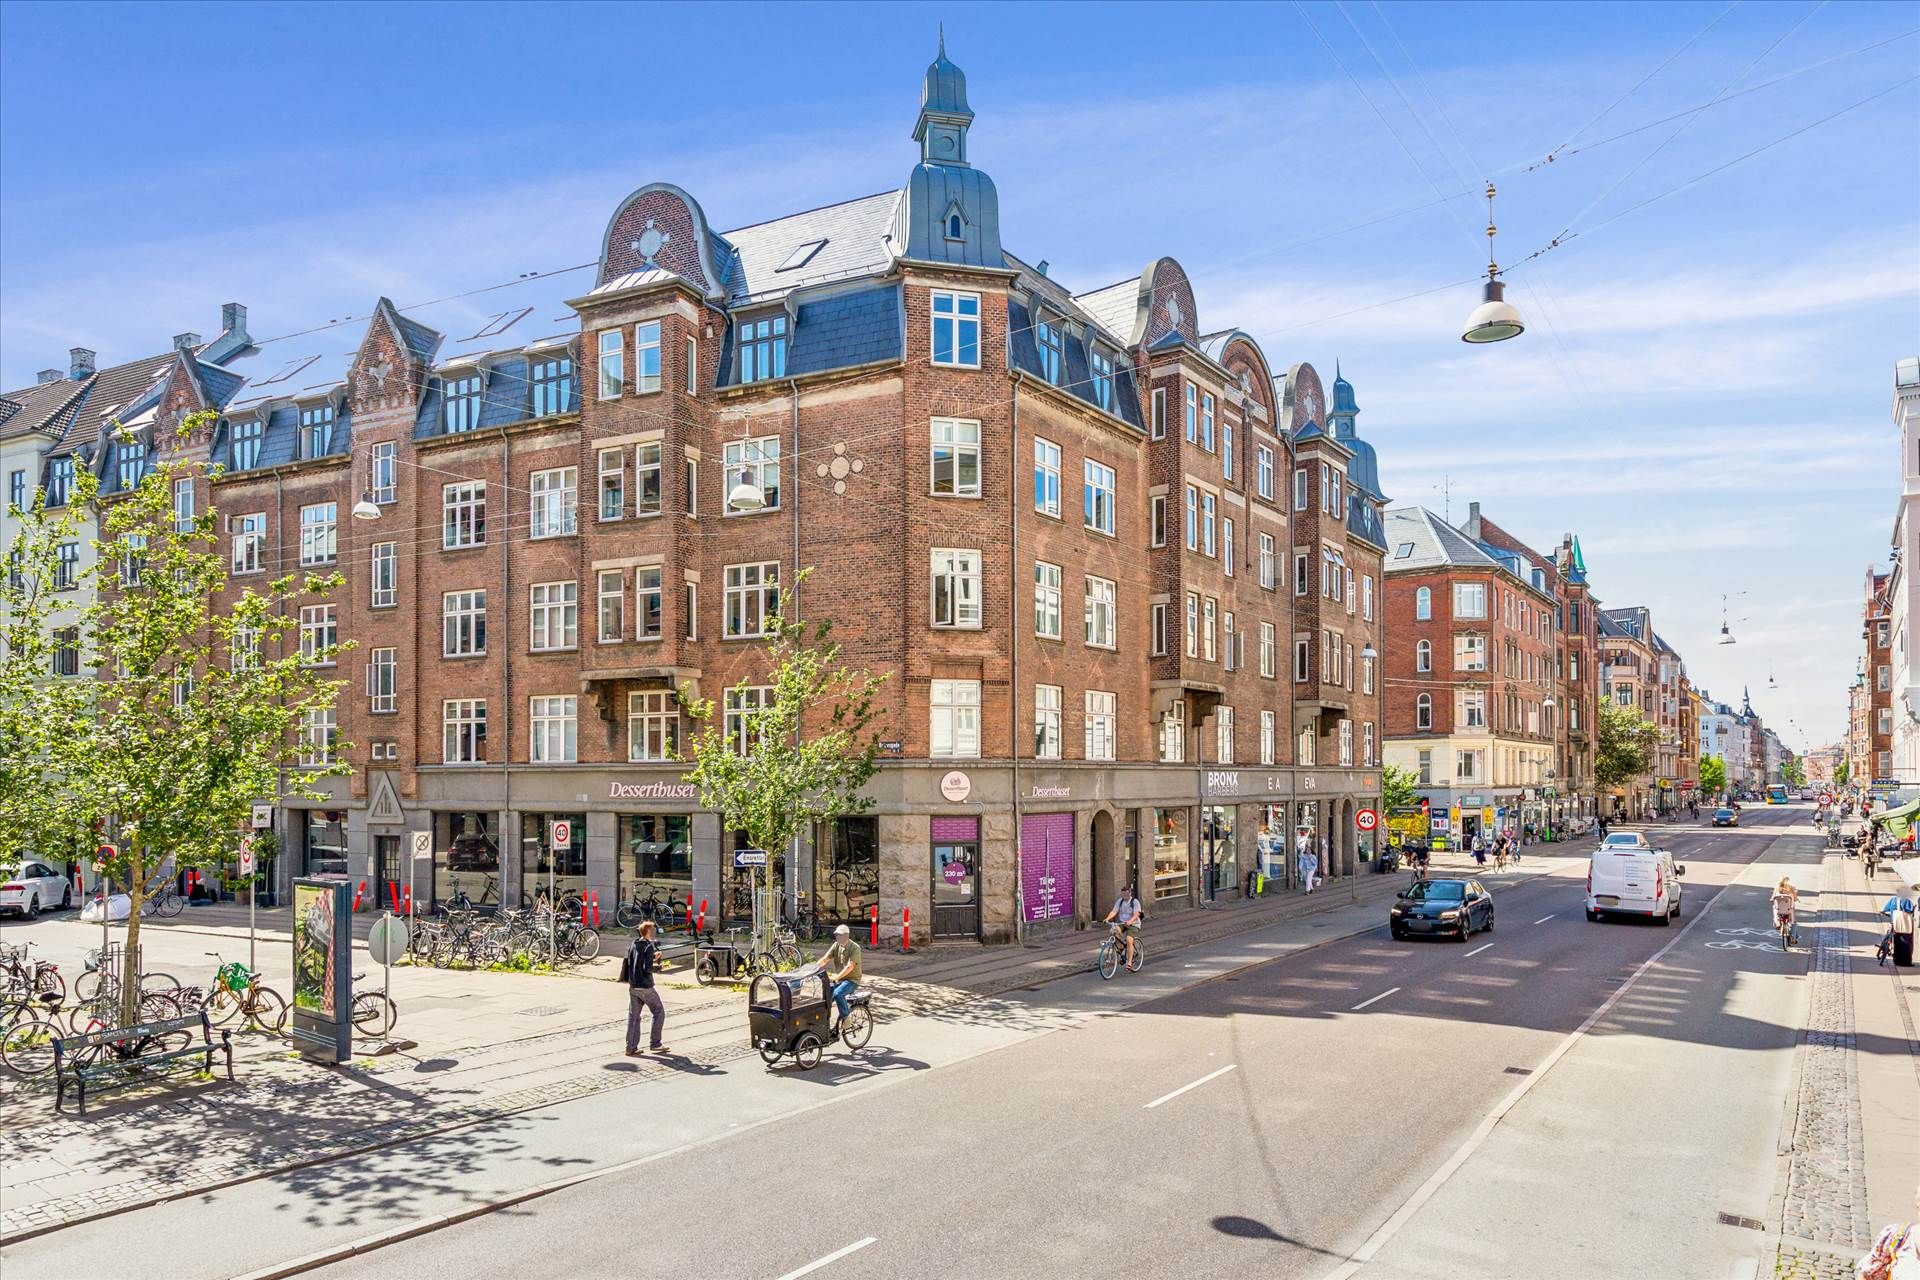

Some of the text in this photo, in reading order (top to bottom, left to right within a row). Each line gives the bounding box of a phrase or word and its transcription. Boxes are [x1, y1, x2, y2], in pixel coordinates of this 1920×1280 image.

[1208, 772, 1239, 786] BRONX
[1304, 777, 1316, 790] EVA
[609, 781, 696, 798] Desserthuset
[1360, 816, 1374, 825] 40
[557, 829, 567, 837] 40
